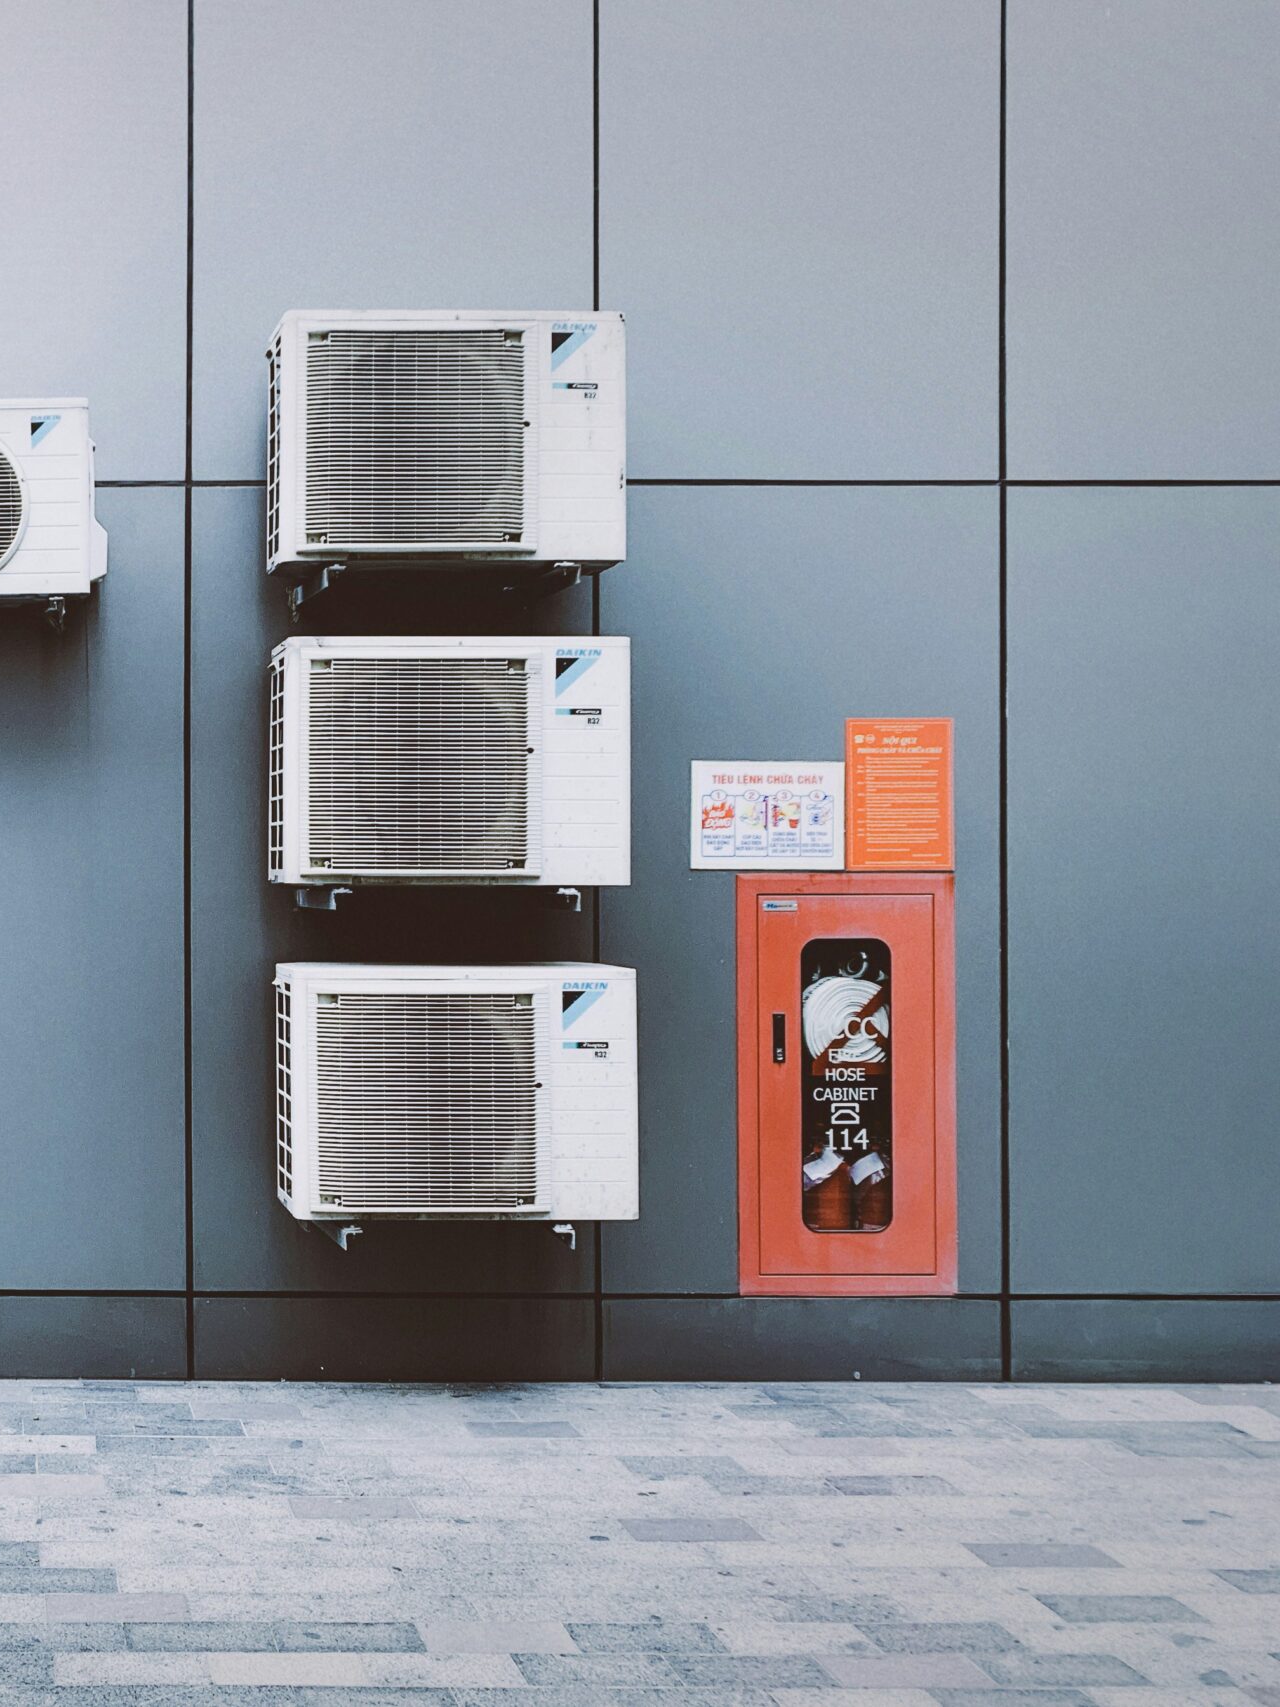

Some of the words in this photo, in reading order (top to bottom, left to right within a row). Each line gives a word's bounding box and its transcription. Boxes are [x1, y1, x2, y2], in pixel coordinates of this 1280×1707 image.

[556, 649, 602, 657] DAIKIN
[562, 982, 608, 990] DAIKIN
[825, 1067, 866, 1082] HOSE
[813, 1087, 878, 1102] CABINET
[824, 1128, 869, 1151] 114
